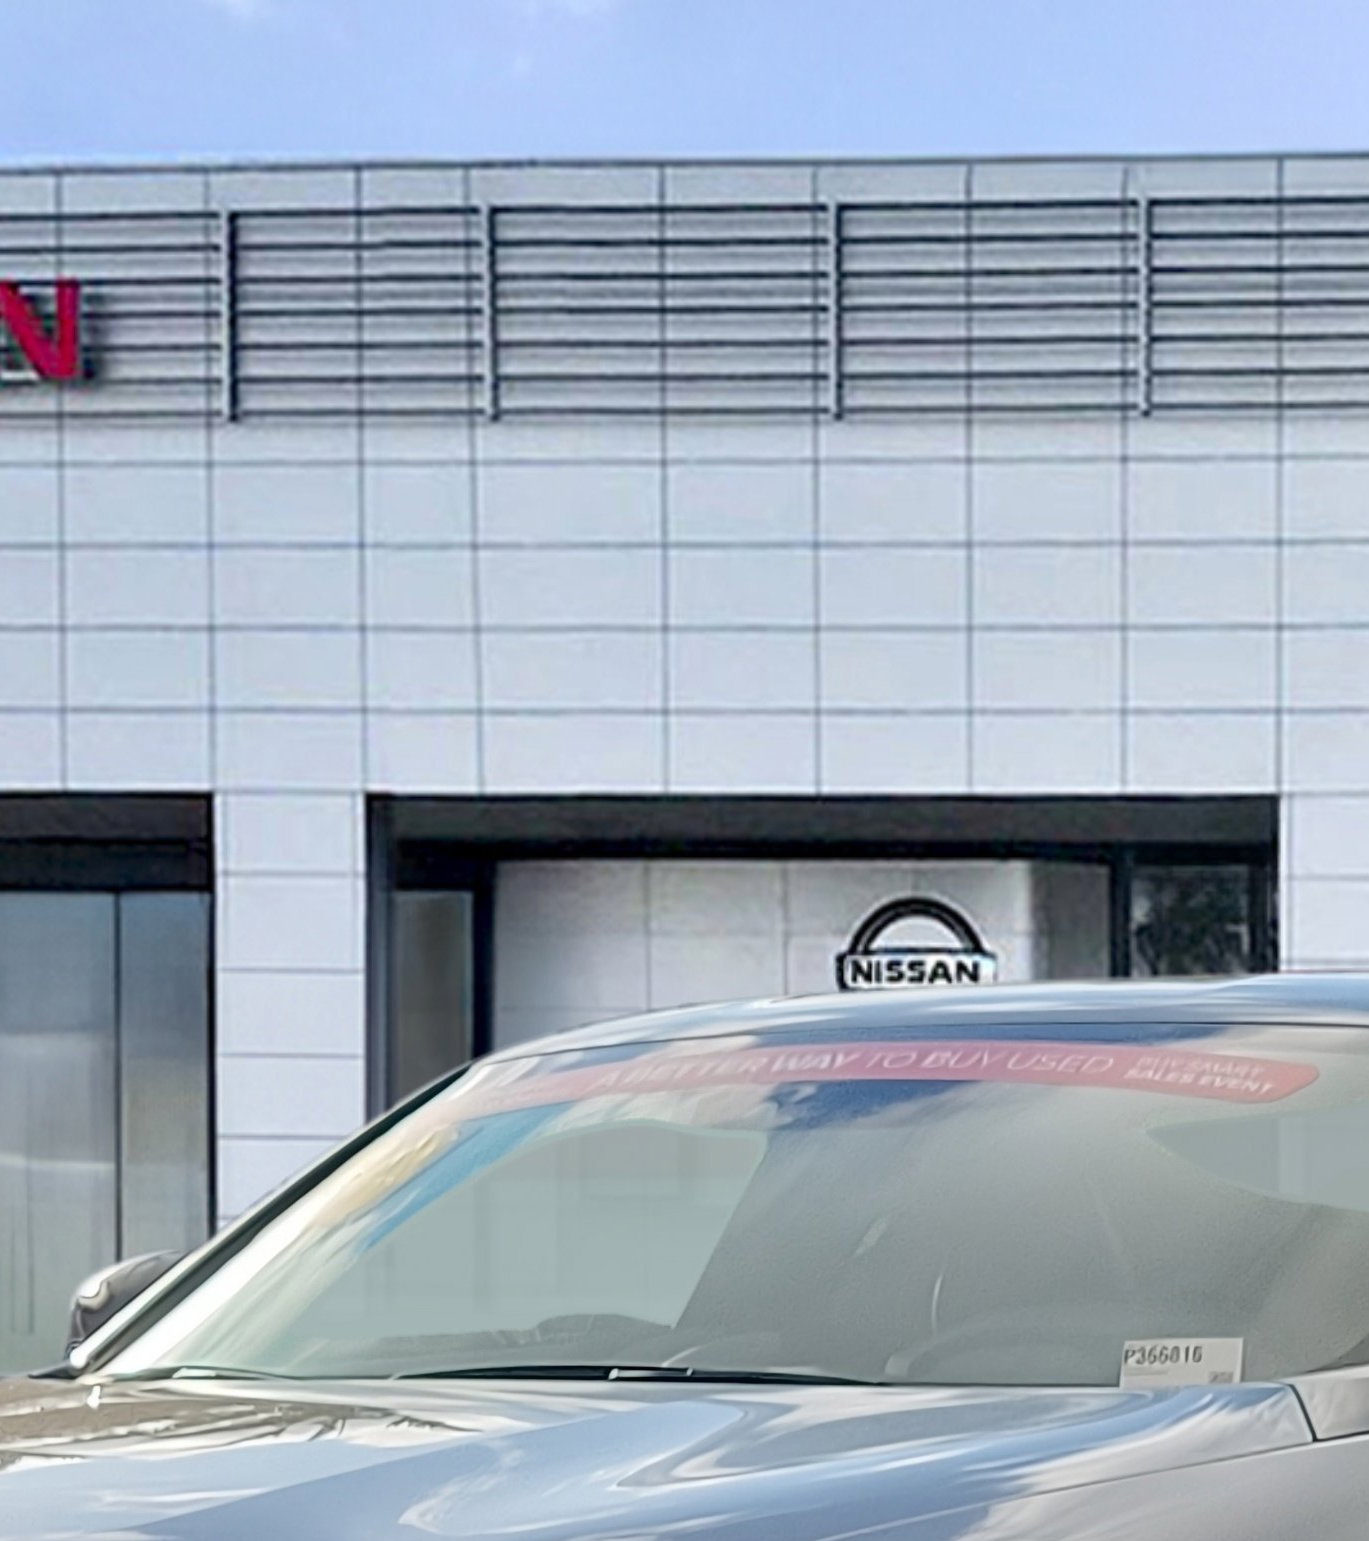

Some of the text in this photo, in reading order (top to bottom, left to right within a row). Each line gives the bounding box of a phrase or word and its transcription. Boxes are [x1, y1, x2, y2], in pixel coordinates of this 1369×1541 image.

[850, 959, 981, 985] NISSAN
[769, 1051, 861, 1073] WAY
[865, 1051, 917, 1069] TO
[919, 1049, 1007, 1069] BUY
[1007, 1051, 1115, 1073] USED
[1123, 1068, 1275, 1095] SALES EVENT
